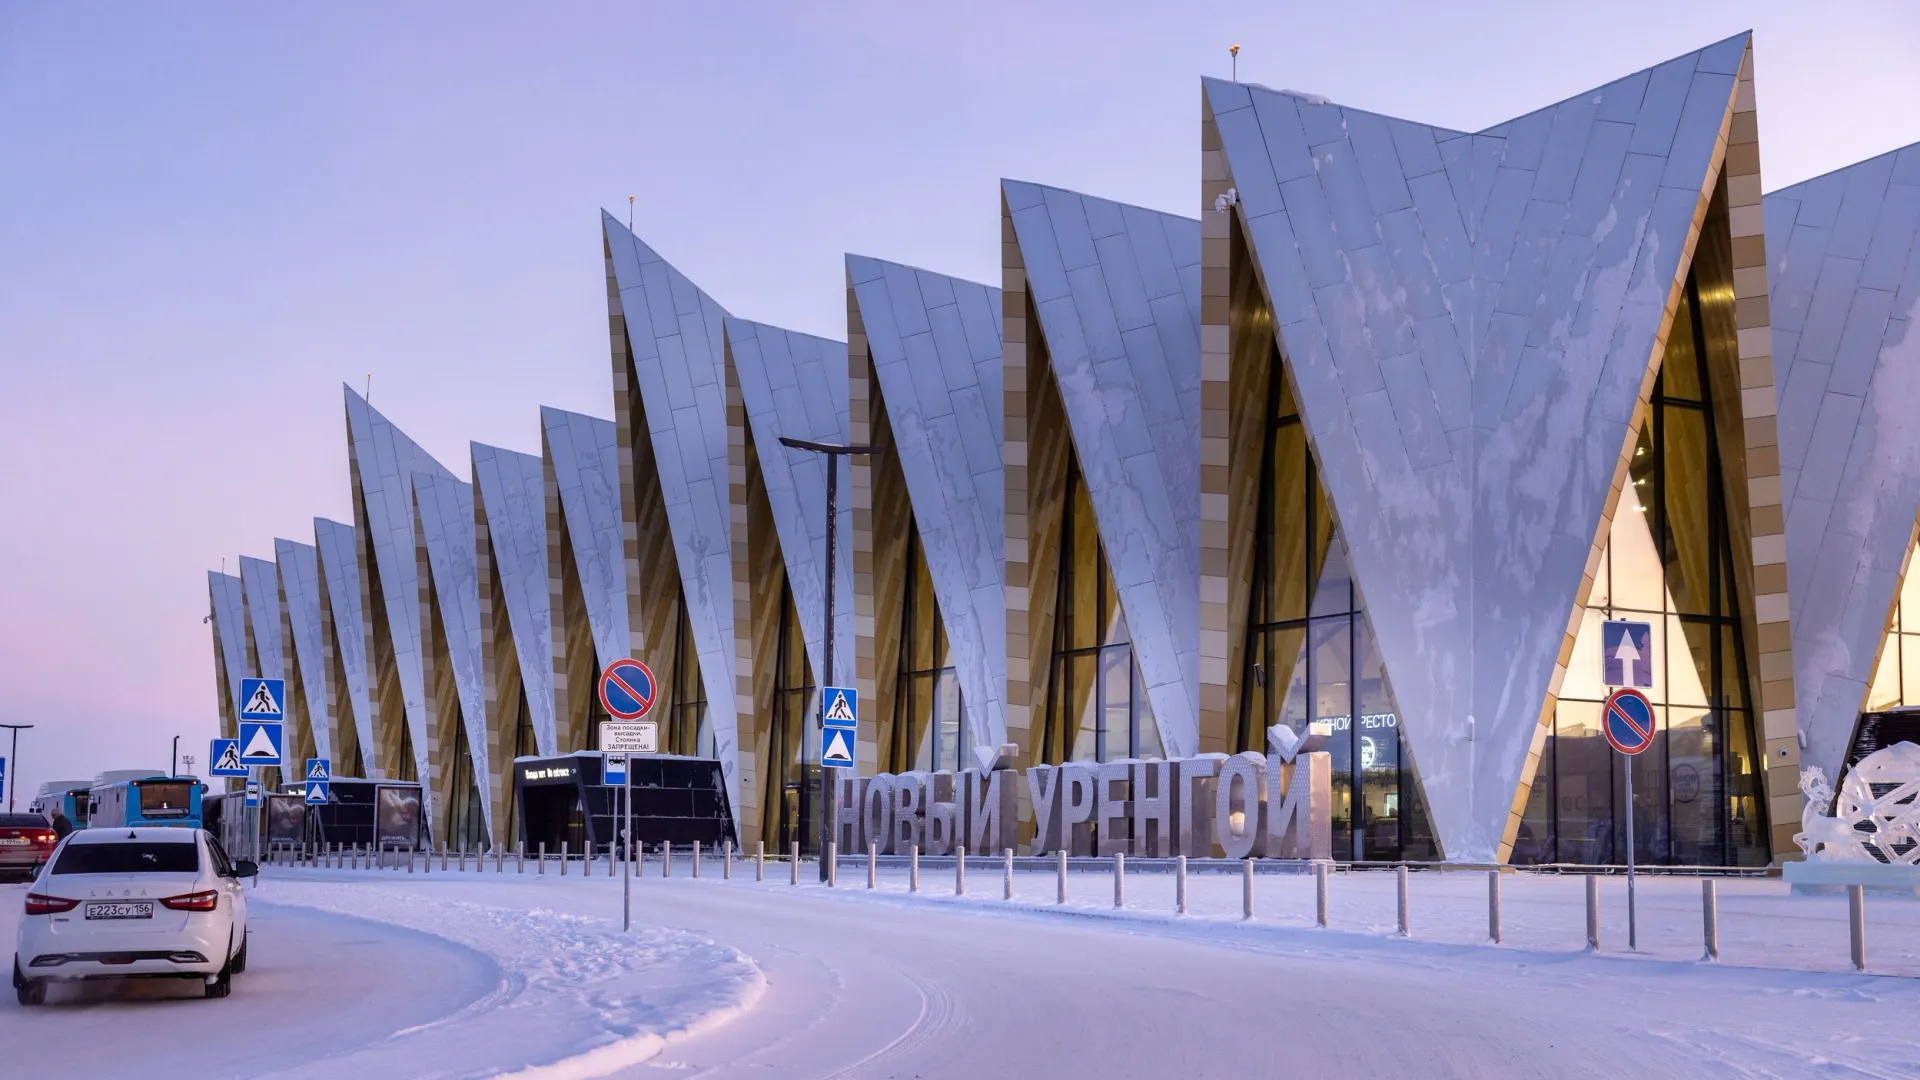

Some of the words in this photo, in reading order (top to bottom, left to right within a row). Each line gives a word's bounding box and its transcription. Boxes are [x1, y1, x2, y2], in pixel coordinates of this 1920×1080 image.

[1361, 713, 1397, 729] РЕСТО
[836, 743, 1018, 856] НОВЫЙ
[1027, 722, 1332, 860] УРЕНГОЙ
[134, 904, 150, 913] 156
